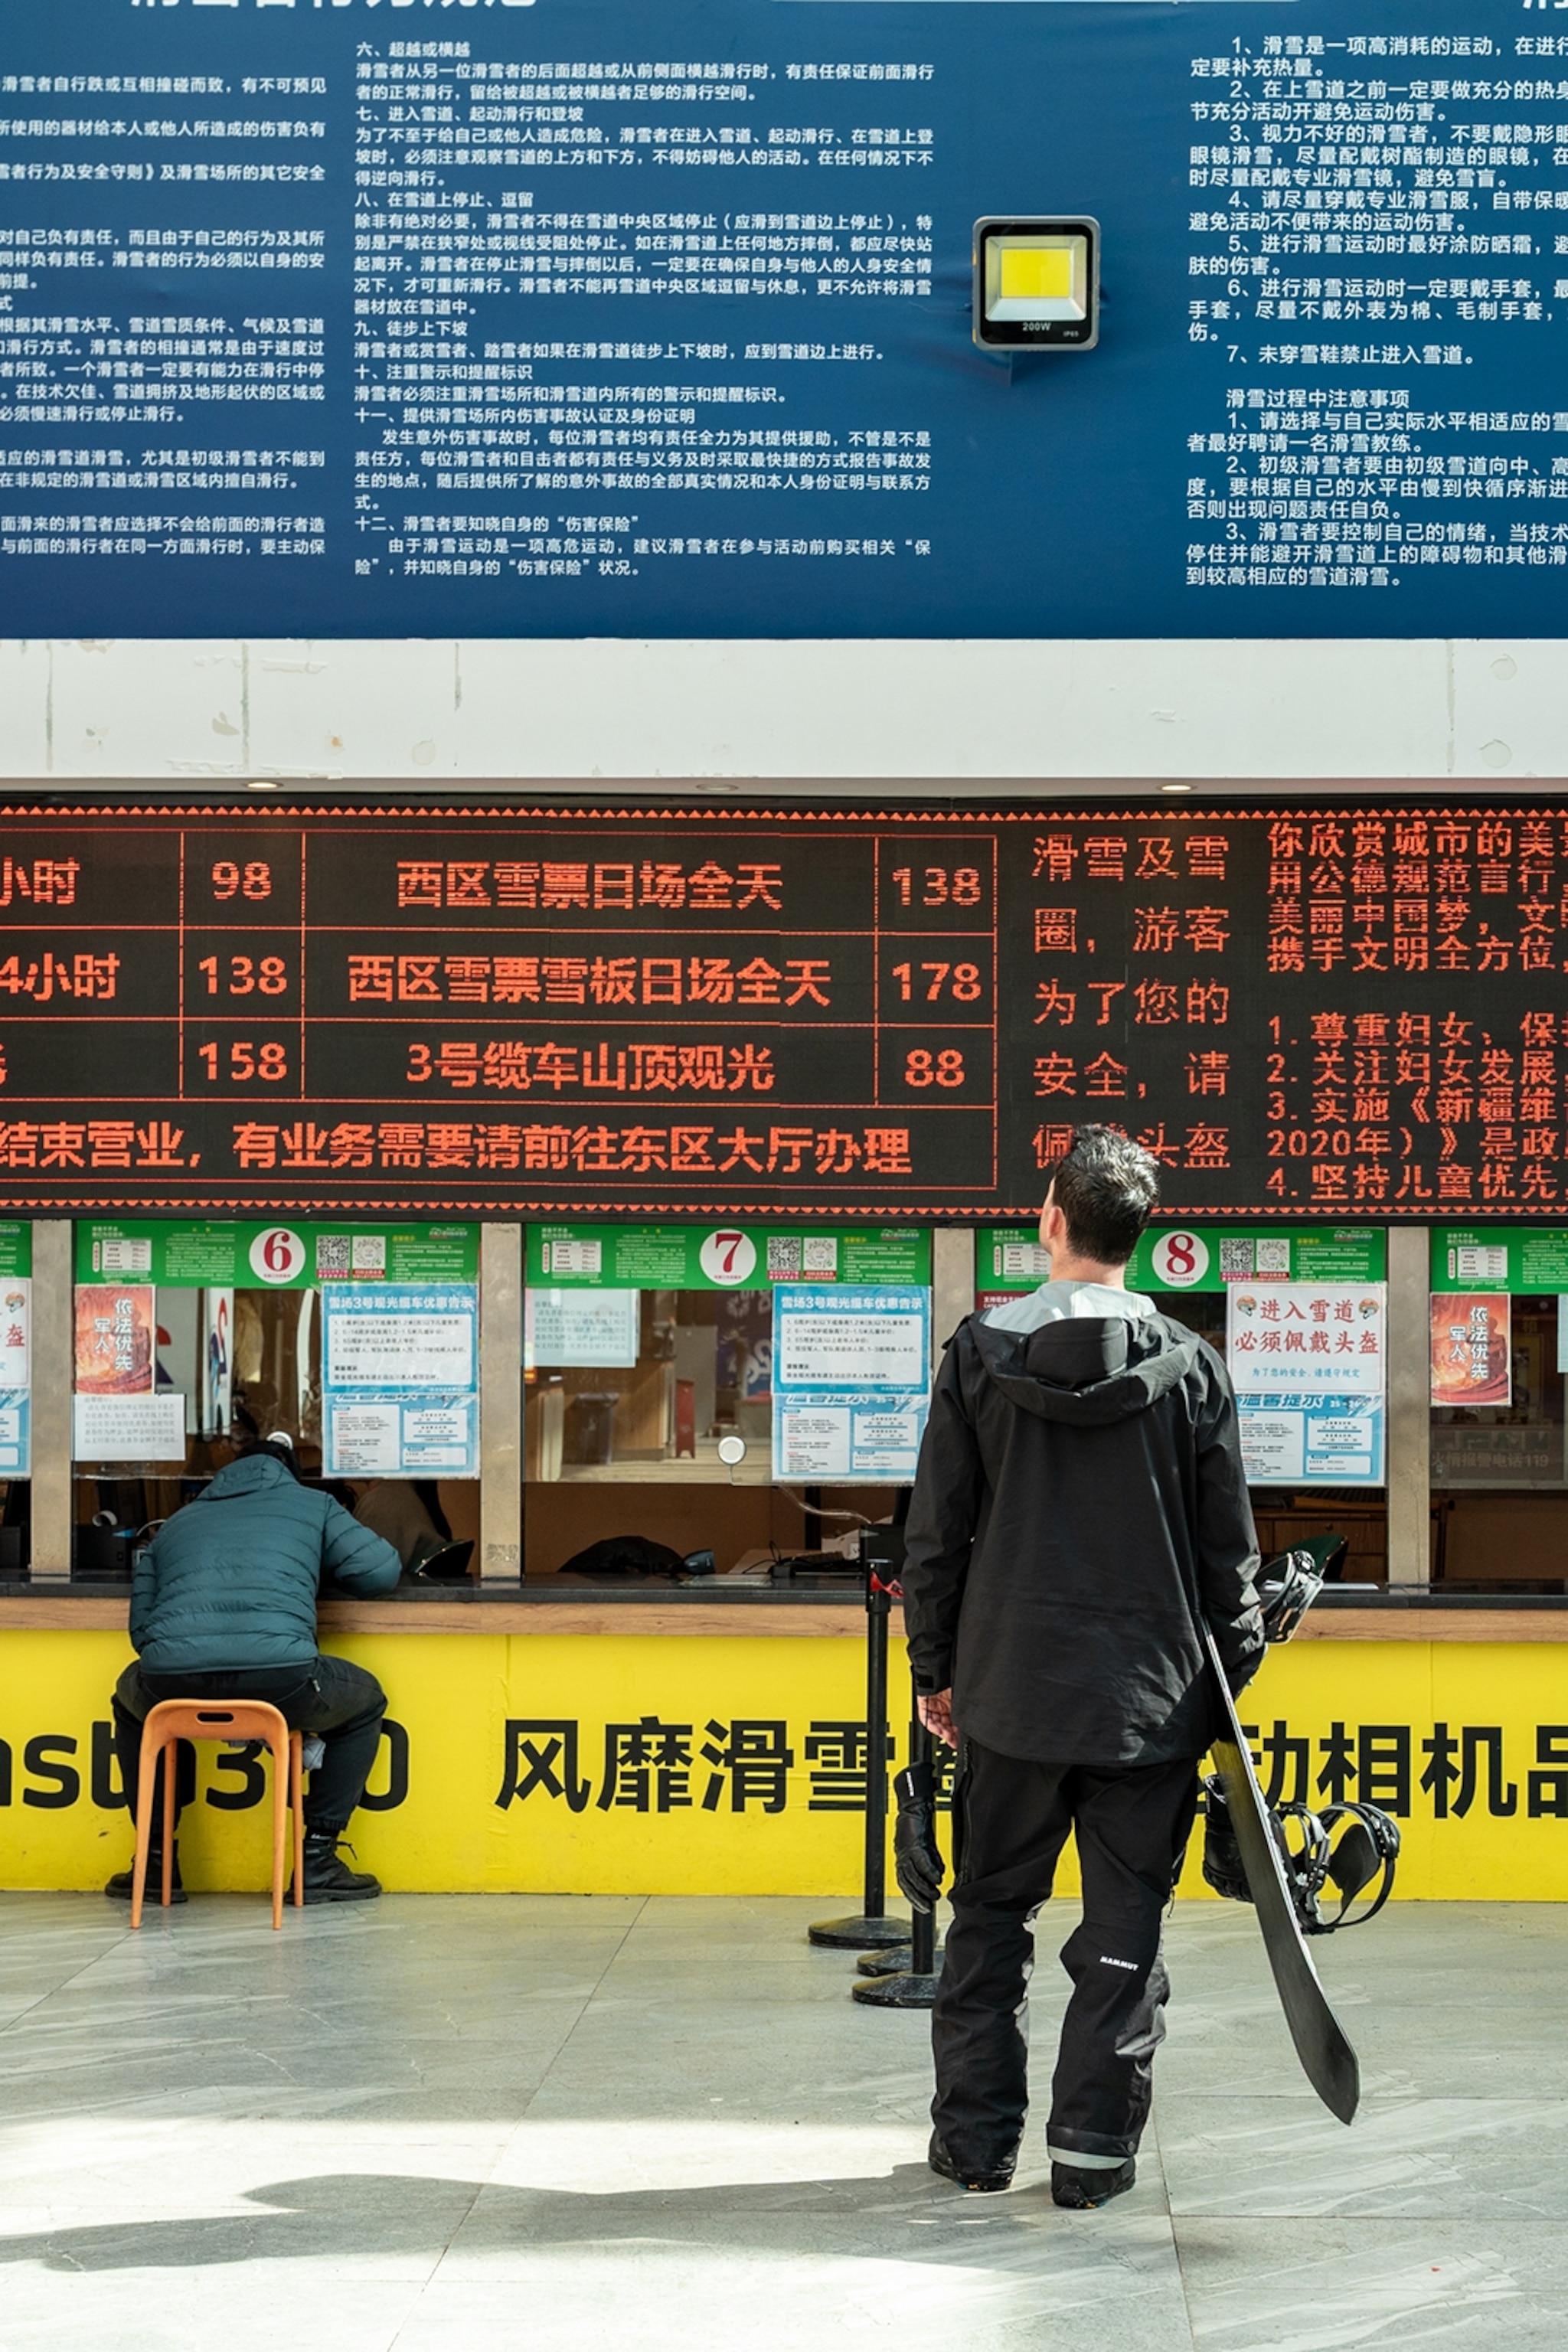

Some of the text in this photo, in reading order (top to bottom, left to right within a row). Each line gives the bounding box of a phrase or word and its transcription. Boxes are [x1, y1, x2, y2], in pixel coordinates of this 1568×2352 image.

[357, 41, 470, 57] 六、超越或横越
[1191, 57, 1323, 77] 定要补充热量。
[356, 84, 755, 100] 者的正常滑行，留给被超越或被横越者足够的滑行空间。
[356, 106, 583, 122] 七、进入雪道、起动滑行和登坡
[1191, 102, 1446, 121] 节充分活动开避免运动伤害。
[355, 170, 444, 186] 得逆向滑行。
[355, 192, 533, 207] 八、在雪道上停止、逗留
[1189, 212, 1464, 231] 避免活动不便带来的运动伤害。
[1189, 256, 1279, 275] 肤的伤害。
[354, 299, 475, 315] 器材放在雪道中。
[354, 321, 467, 337] 九、徒步上下坡
[1022, 322, 1051, 332] 200W
[1188, 322, 1218, 341] 伤。
[0, 339, 324, 356] 滑行方式。滑雪者的相撞通常是由于速度过
[1227, 345, 1472, 364] 7、未穿雪鞋禁止进入雪道。
[354, 364, 532, 380] 十、注重警示和提醒标识
[1227, 389, 1409, 408] 滑雪过程中注意事项
[354, 407, 694, 424] 十一、提供滑雪场所内伤害事故认证及身份证明
[1187, 433, 1421, 452] 者最好聘请一名滑雪教练。
[355, 495, 379, 510] 式。
[1187, 500, 1400, 519] 否则出现问题责任自负。
[355, 516, 638, 532] 十二、滑雪者要知晓自身的“伤害保险”
[355, 558, 638, 576] 险”，并知晓自身的“伤害保险”状况。
[1187, 567, 1400, 586] 到较高相应的雪道滑雪。
[1268, 822, 1568, 858] 你欣赏城市的美
[1033, 835, 1228, 880] 滑雪及雪
[213, 862, 270, 899] 98
[397, 861, 782, 910] 西区雪票日场全天
[893, 868, 980, 905] 138
[1269, 895, 1568, 934] 美丽中国梦，文
[1036, 906, 1230, 952] 圈，游客
[200, 956, 286, 994] 138
[348, 956, 830, 1006] 西区雪票雪板日场全天
[893, 963, 981, 1000] 178
[1034, 979, 1228, 1025] 为了您的
[1269, 1012, 1568, 1047] 1.尊重妇女、保
[200, 1043, 286, 1080] 158
[407, 1042, 775, 1090] 3号缆车山顶观光
[906, 1050, 964, 1086] 88
[1034, 1051, 1228, 1097] 安全，请
[1268, 1086, 1568, 1122] 3.实施《新疆维
[1031, 1121, 1231, 1170] 佩头盔
[1268, 1128, 1568, 1161] 2020年）》是政
[263, 1231, 292, 1271] 6
[715, 1233, 743, 1272] 7
[1167, 1234, 1196, 1275] 8
[780, 1296, 923, 1310] 雪场3号观光缆车优惠告示
[1260, 1299, 1356, 1323] 进入雪道
[94, 1318, 111, 1354] 军人
[115, 1298, 133, 1371] 依法优先
[1235, 1330, 1380, 1354] 必须佩戴头盔
[1449, 1326, 1466, 1362] 军人
[1470, 1306, 1488, 1380] 依法优先
[1101, 1956, 1139, 1971] MAMMUT
